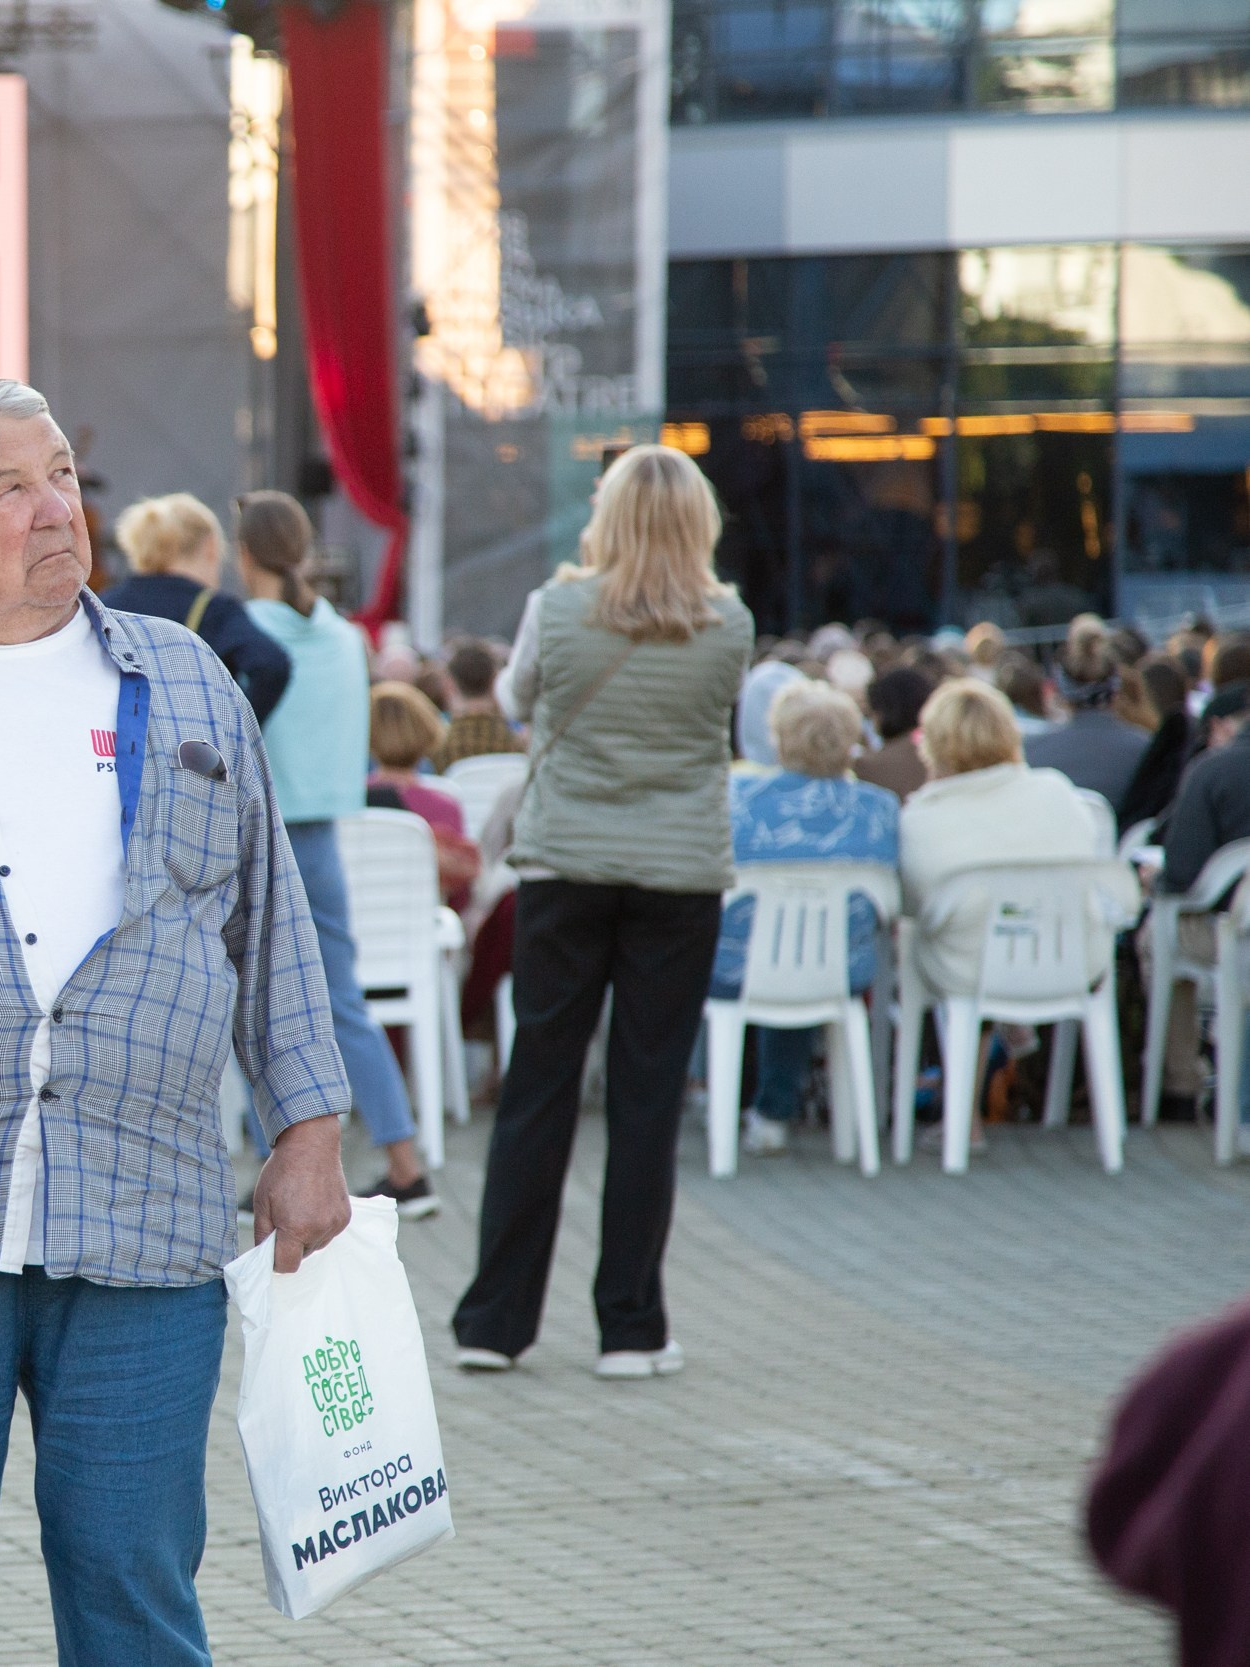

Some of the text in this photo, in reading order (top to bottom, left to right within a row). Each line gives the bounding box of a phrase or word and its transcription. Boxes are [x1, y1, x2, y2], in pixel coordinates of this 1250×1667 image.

[96, 762, 117, 773] PS
[302, 1340, 361, 1385] ДОБРО
[311, 1365, 373, 1412] СОСЕД
[323, 1400, 367, 1437] СТВО
[343, 1440, 373, 1458] ФОНД
[318, 1453, 413, 1512] Виктора
[291, 1468, 448, 1571] МАСЛАКОВА
